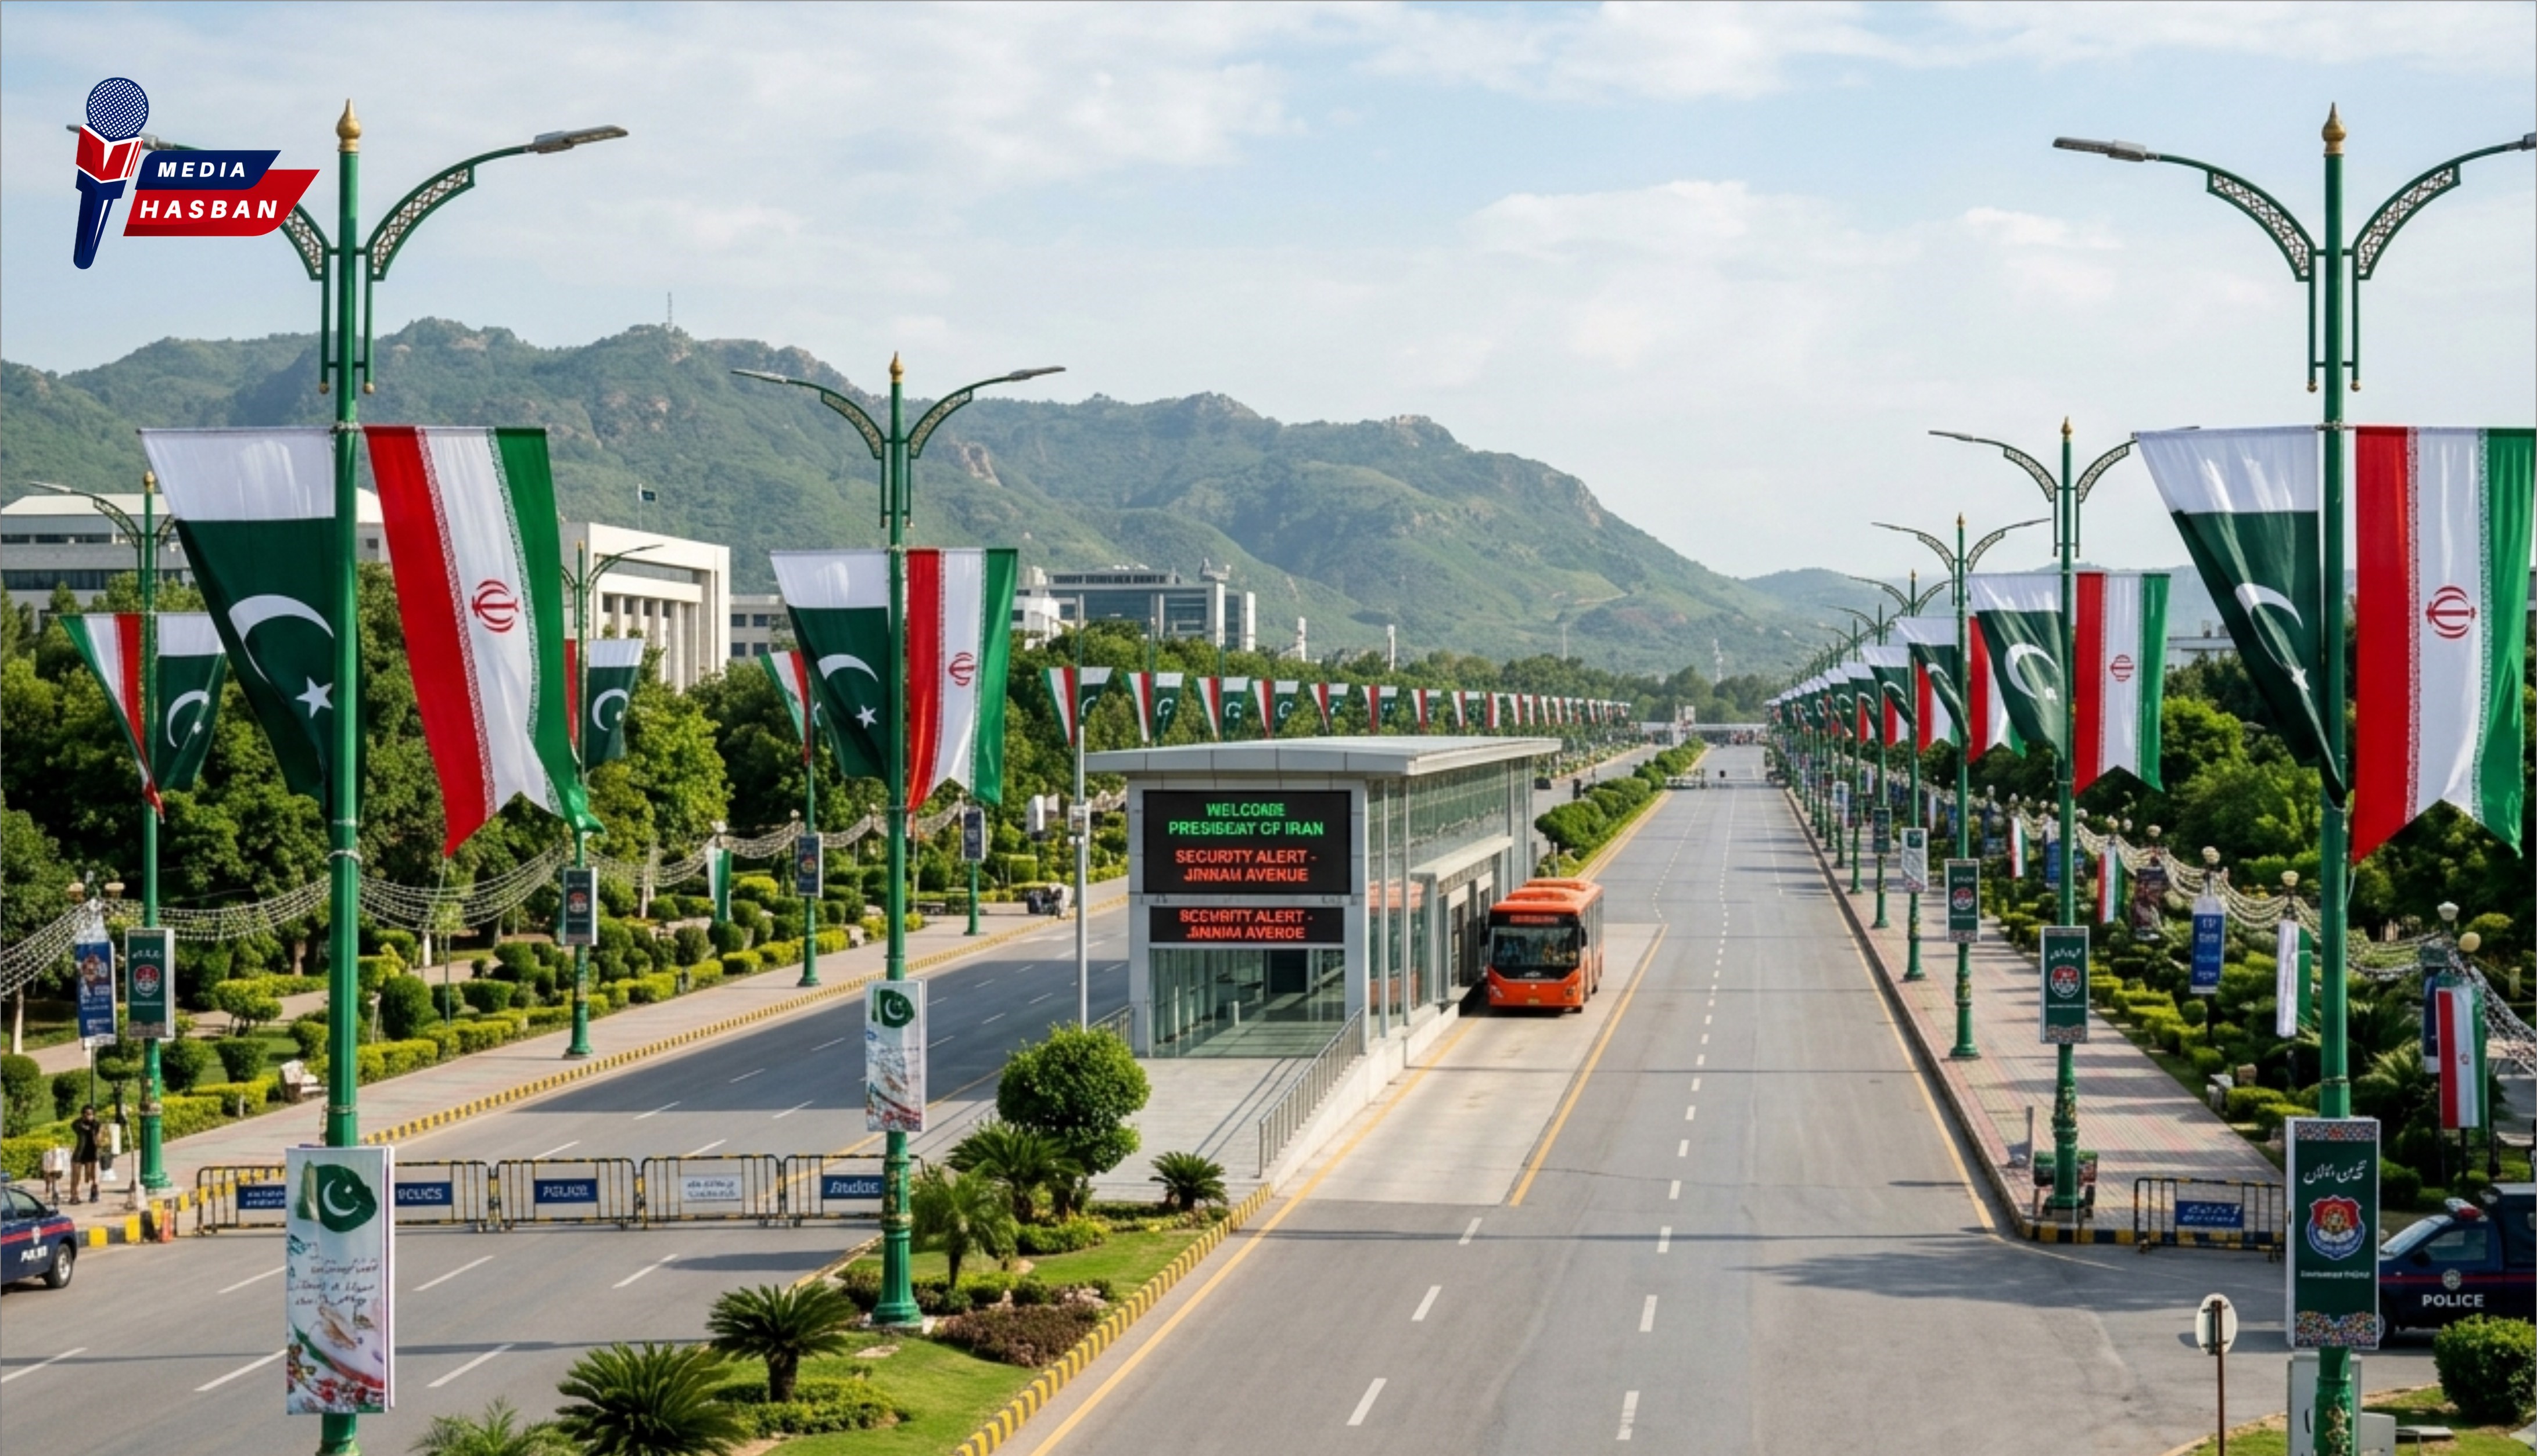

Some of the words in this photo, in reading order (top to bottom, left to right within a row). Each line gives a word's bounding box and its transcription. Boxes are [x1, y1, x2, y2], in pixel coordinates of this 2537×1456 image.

[1285, 821, 1323, 835] IRAN
[1255, 850, 1308, 864] ALERT
[1255, 909, 1305, 923] ALERT
[2421, 1293, 2485, 1308] POLICE
